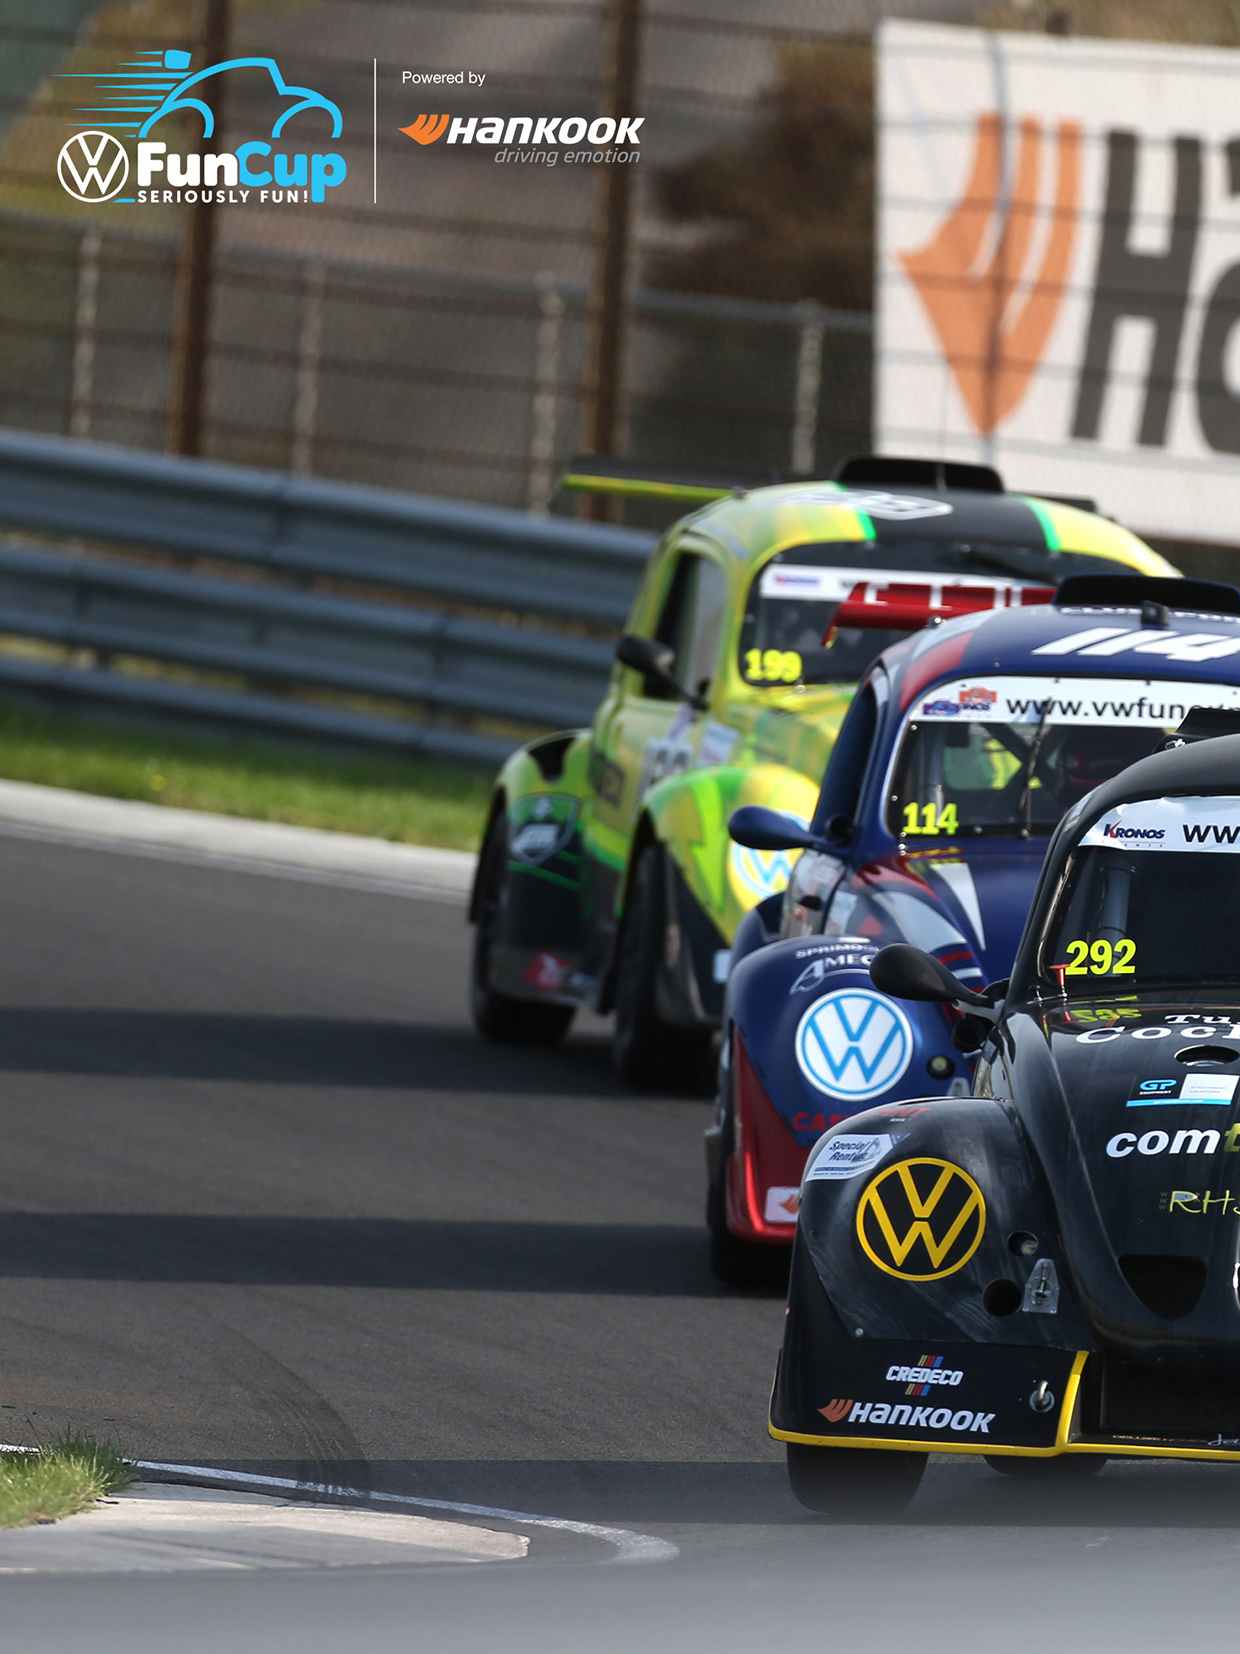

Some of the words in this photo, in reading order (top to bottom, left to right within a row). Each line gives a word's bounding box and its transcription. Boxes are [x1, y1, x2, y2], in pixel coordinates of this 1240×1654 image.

[744, 649, 803, 683] 199
[902, 801, 960, 836] 114
[1103, 820, 1166, 840] KRONOS
[1066, 938, 1138, 977] 292
[1139, 1079, 1178, 1091] GP
[828, 1140, 869, 1153] Special
[885, 1365, 965, 1387] CREDECO
